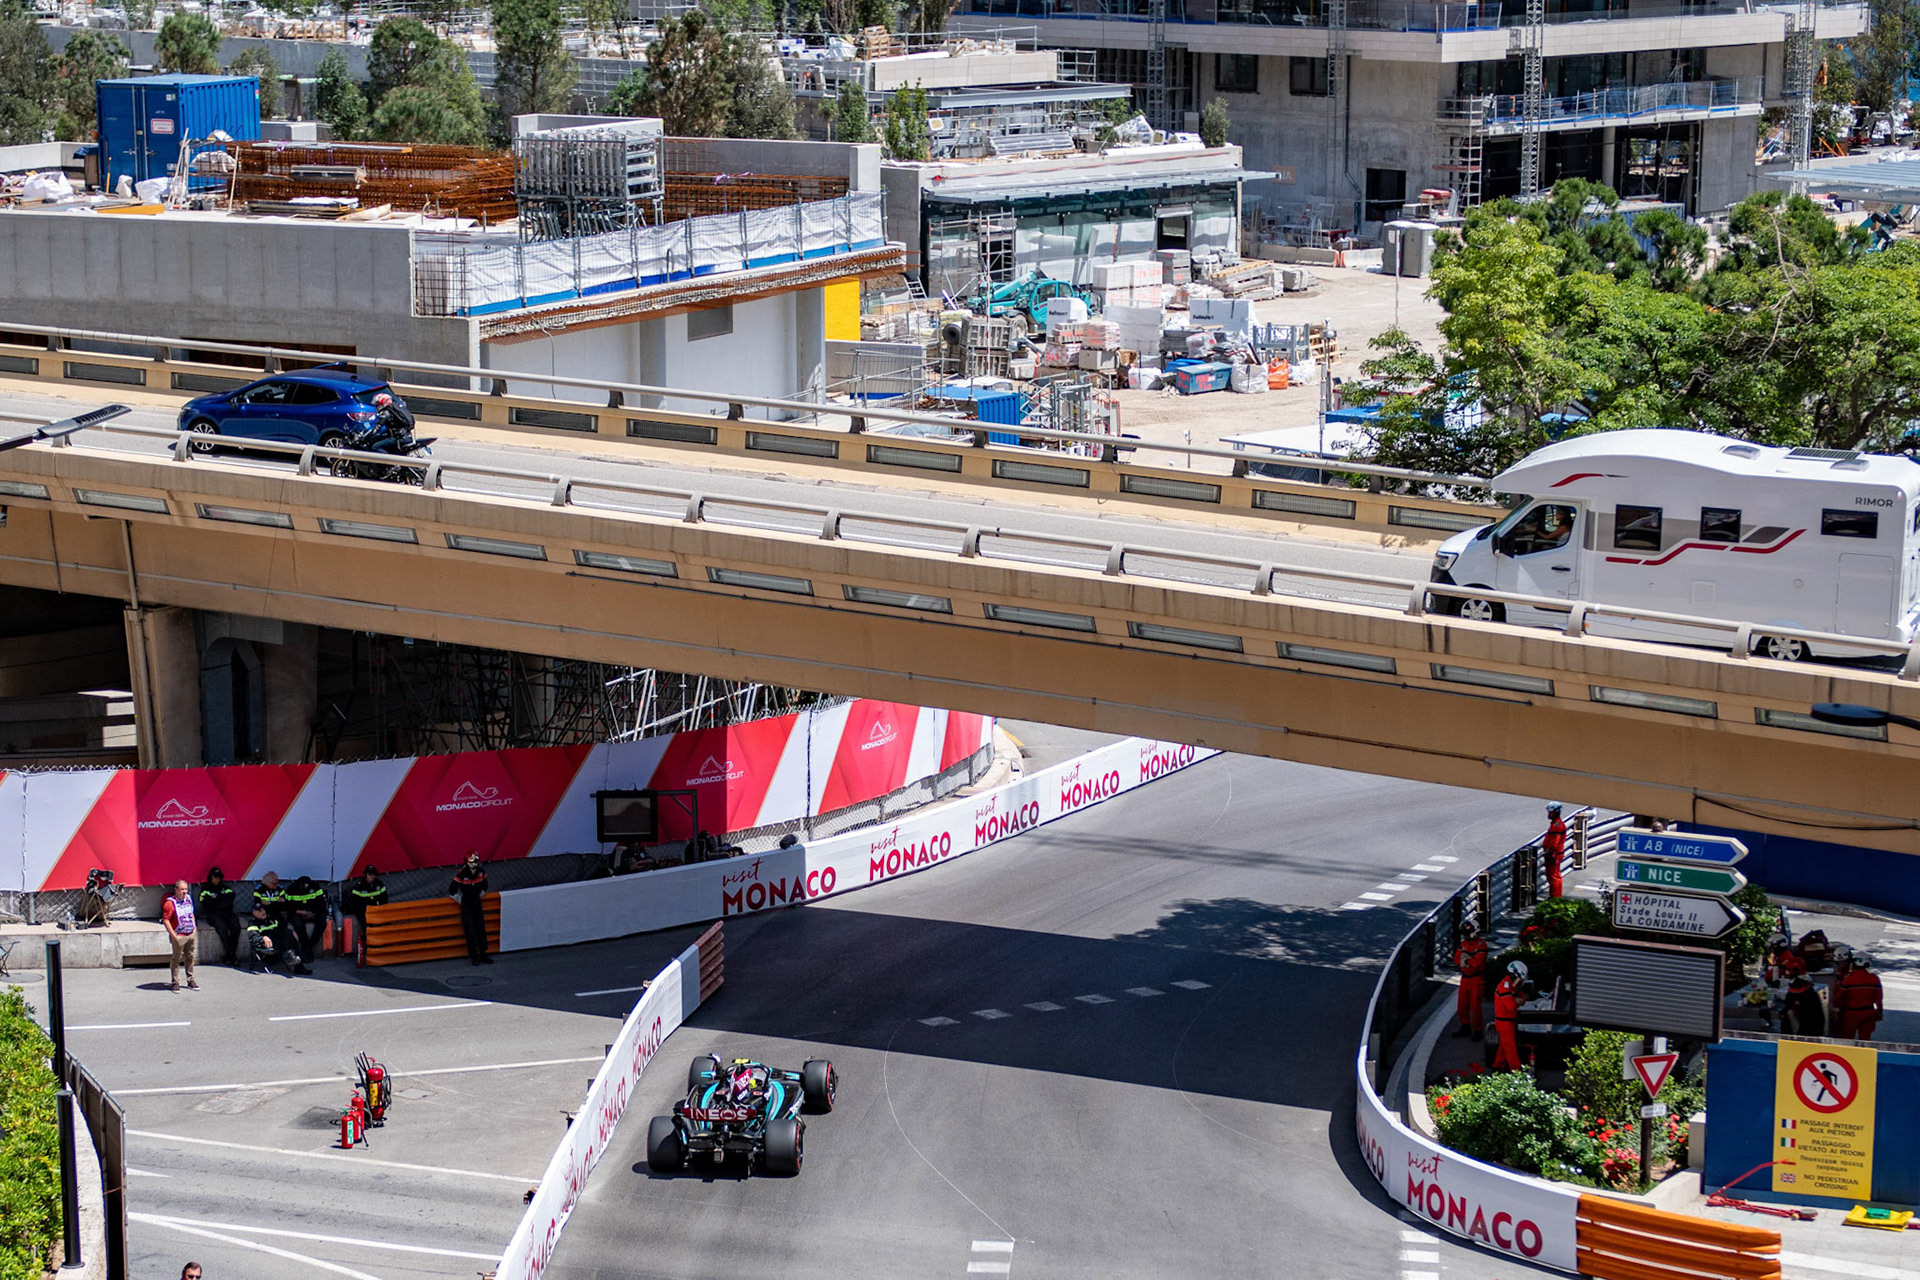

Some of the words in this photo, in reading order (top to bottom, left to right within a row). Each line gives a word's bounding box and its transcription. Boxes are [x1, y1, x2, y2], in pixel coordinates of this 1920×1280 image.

[1855, 496, 1894, 508] RIMOR
[1140, 743, 1195, 783] MONACO
[1061, 761, 1082, 786] visit
[1060, 770, 1120, 812] MONACO
[436, 798, 513, 811] MONACOCIRCUIT
[975, 794, 999, 820] visit
[138, 818, 225, 828] MONACOCIRCUIT
[975, 800, 1040, 847] MONACO
[871, 825, 901, 854] visit
[1644, 840, 1663, 851] A8
[1671, 843, 1704, 856] (NICE)
[869, 831, 952, 882] MONACO
[722, 858, 764, 887] visit
[1648, 868, 1682, 883] NICE
[722, 866, 837, 916] MONACO
[1634, 894, 1681, 909] HÔPITAL
[1620, 905, 1650, 916] Stade
[1655, 908, 1683, 920] Louis
[1620, 916, 1633, 924] LA
[1637, 917, 1705, 932] CONDAMINE
[632, 1016, 662, 1087] MONACO
[599, 1075, 626, 1149] MONACO
[690, 1108, 748, 1120] INEOS
[1800, 1119, 1830, 1127] PASSAGE
[1833, 1122, 1864, 1131] INTERDIT
[1798, 1145, 1827, 1153] VIETATO
[1840, 1149, 1865, 1157] PEDONI
[1812, 1139, 1851, 1148] PASSAGGIO
[1407, 1151, 1445, 1182] visit
[1814, 1182, 1848, 1191] CROSSING
[1817, 1175, 1858, 1185] PEDESTRIAN
[1407, 1171, 1544, 1258] MONACO
